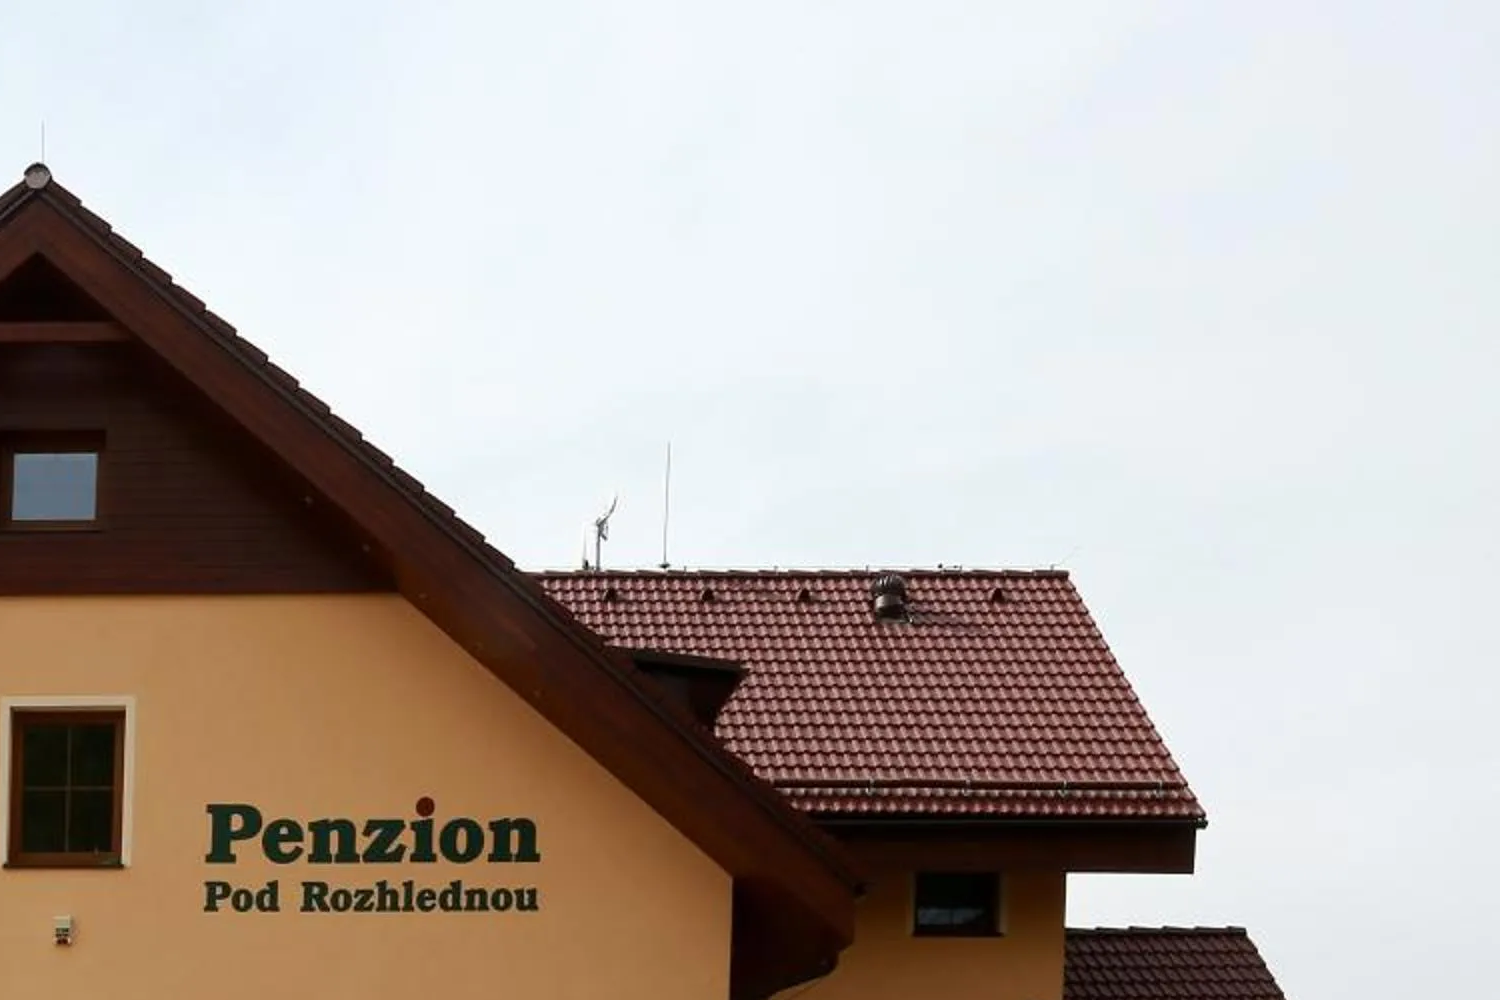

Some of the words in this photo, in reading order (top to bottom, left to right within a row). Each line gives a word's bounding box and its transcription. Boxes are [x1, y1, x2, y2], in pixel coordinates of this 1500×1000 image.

[205, 797, 540, 864] Penzion
[204, 880, 279, 912] Pod
[300, 879, 539, 912] Rozhlednou
